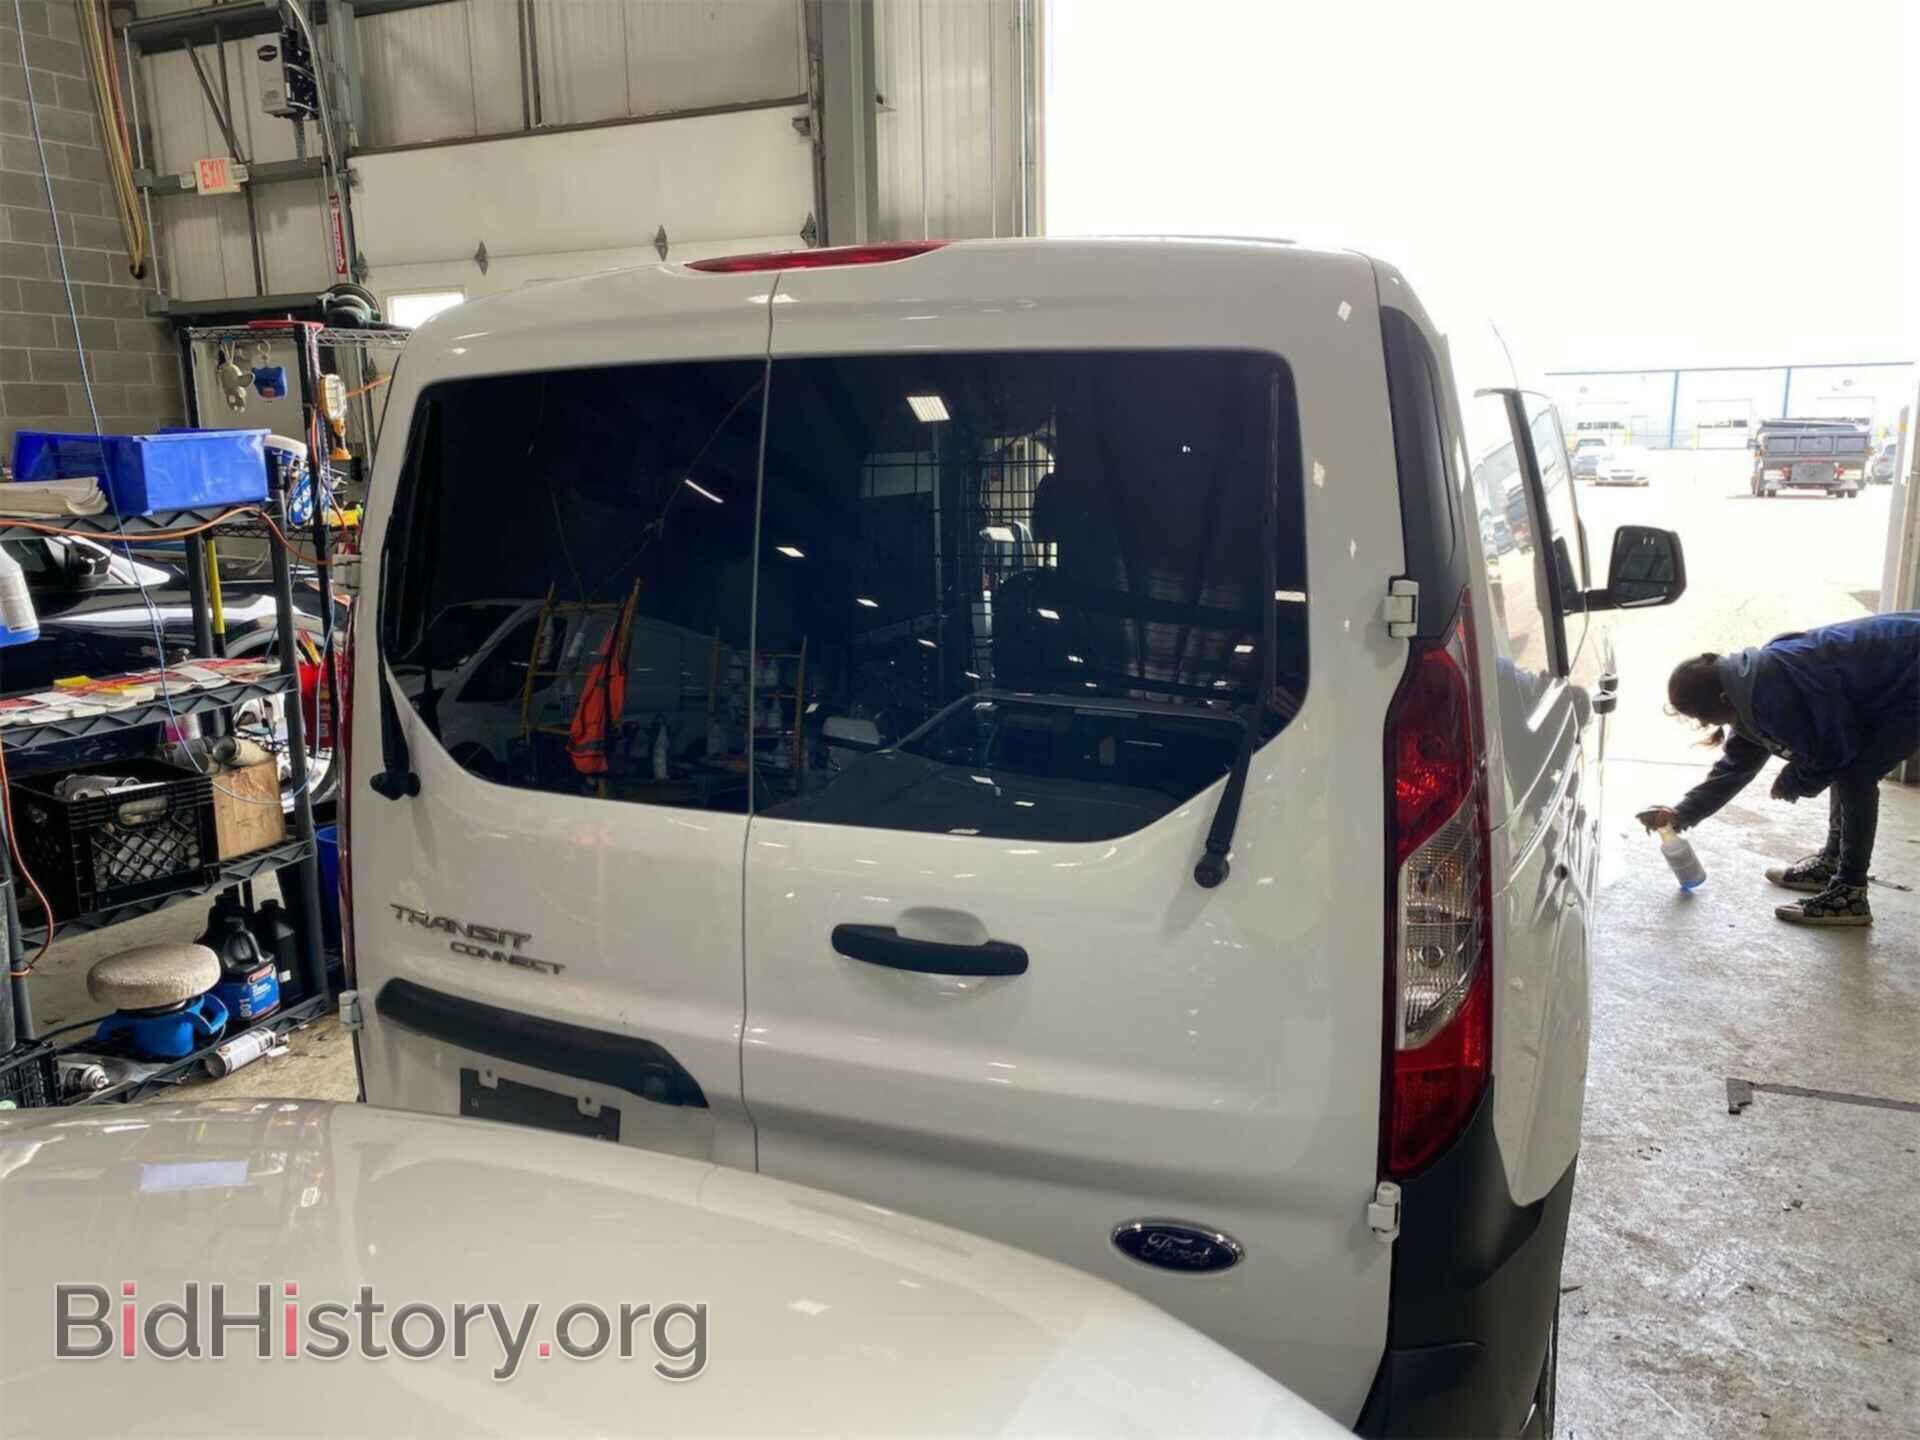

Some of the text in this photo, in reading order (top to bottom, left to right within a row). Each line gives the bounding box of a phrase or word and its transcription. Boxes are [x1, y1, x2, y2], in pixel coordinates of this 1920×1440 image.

[199, 159, 226, 188] EXIT
[390, 903, 533, 950] TRANSIT
[450, 941, 567, 975] CONNECT
[1143, 1232, 1211, 1265] Ford
